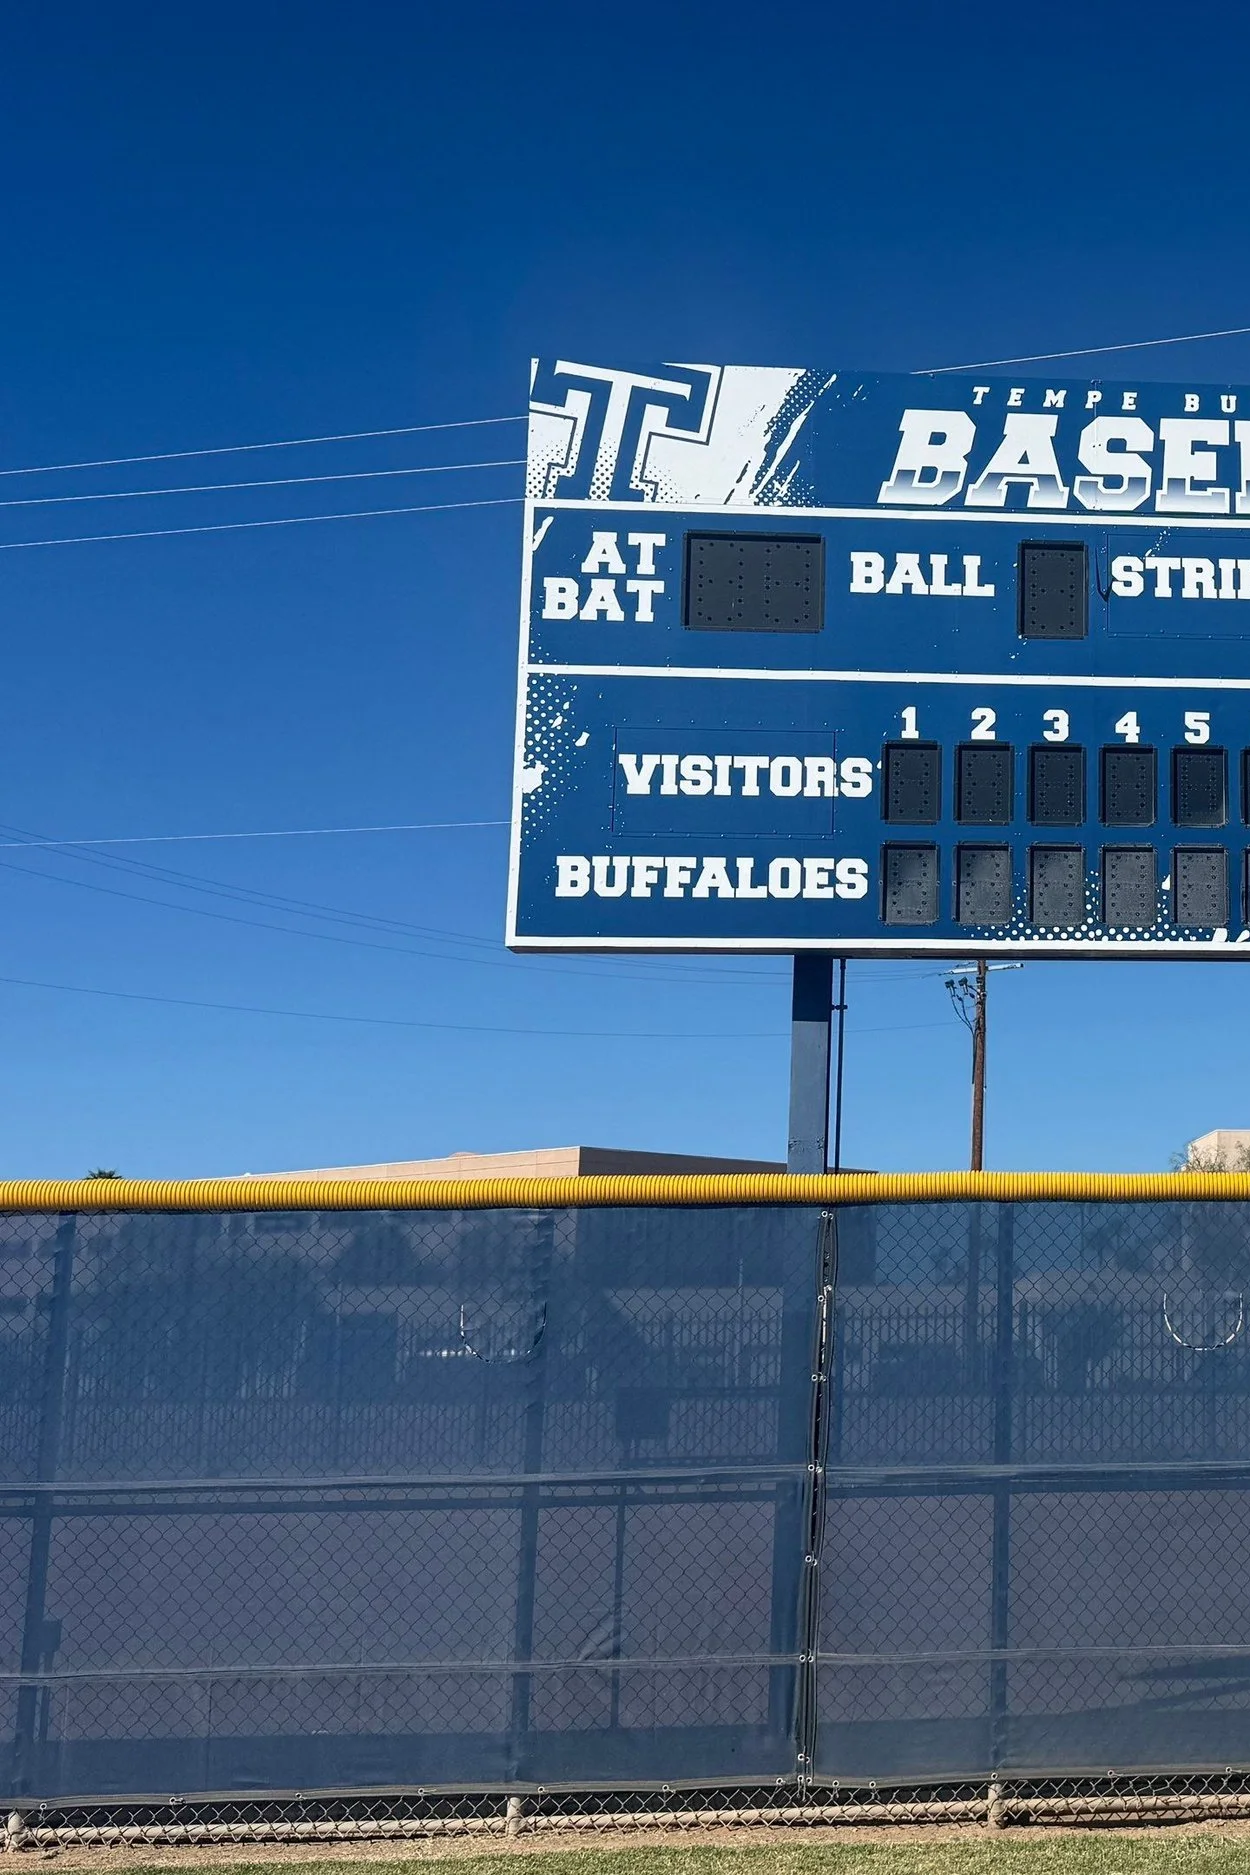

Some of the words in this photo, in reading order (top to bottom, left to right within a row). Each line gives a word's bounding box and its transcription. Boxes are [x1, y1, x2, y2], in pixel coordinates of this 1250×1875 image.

[972, 385, 1139, 411] TEMPE
[581, 531, 667, 575] AT
[849, 551, 995, 597] BALL
[541, 576, 665, 623] BAT
[901, 706, 920, 739] 1
[970, 707, 996, 741] 2
[1043, 709, 1069, 742] 3
[1115, 711, 1141, 744] 4
[1184, 711, 1210, 745] 5
[618, 753, 873, 798] VISITORS
[555, 855, 869, 899] BUFFALOES
